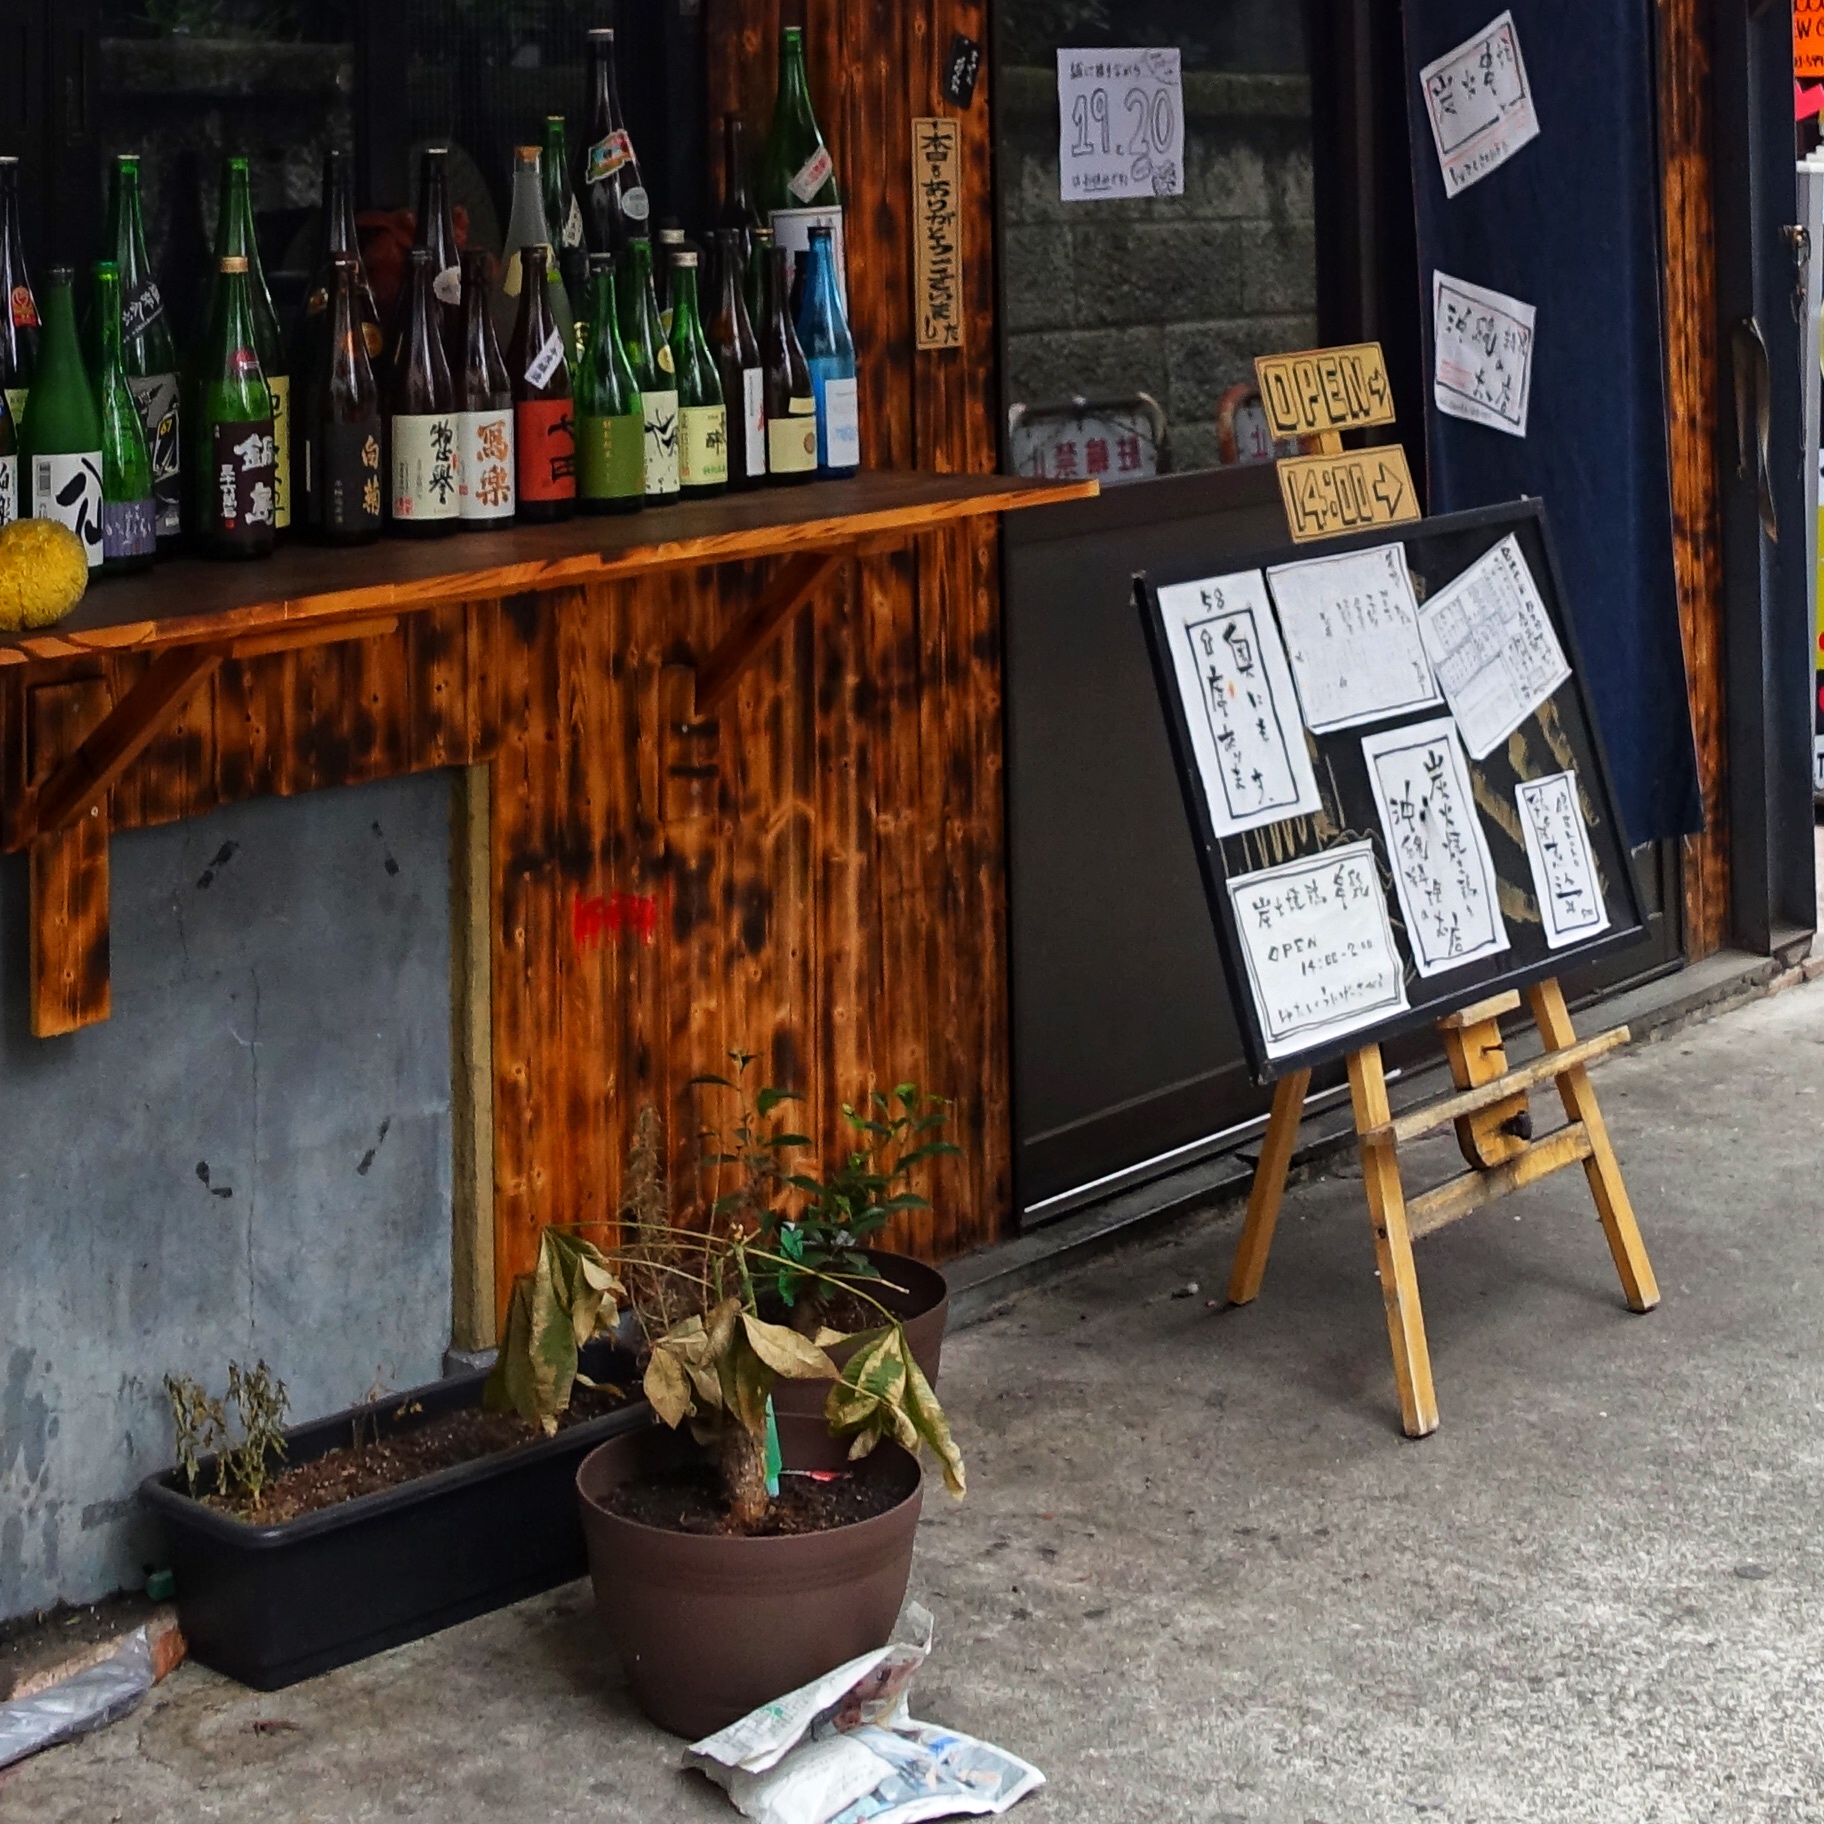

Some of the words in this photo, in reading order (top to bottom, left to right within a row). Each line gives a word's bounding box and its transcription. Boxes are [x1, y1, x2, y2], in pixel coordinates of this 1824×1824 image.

[1262, 354, 1372, 431] OPEN
[233, 432, 274, 526] 鍋島
[1286, 463, 1375, 532] 14:00
[1268, 937, 1318, 962] OPEN
